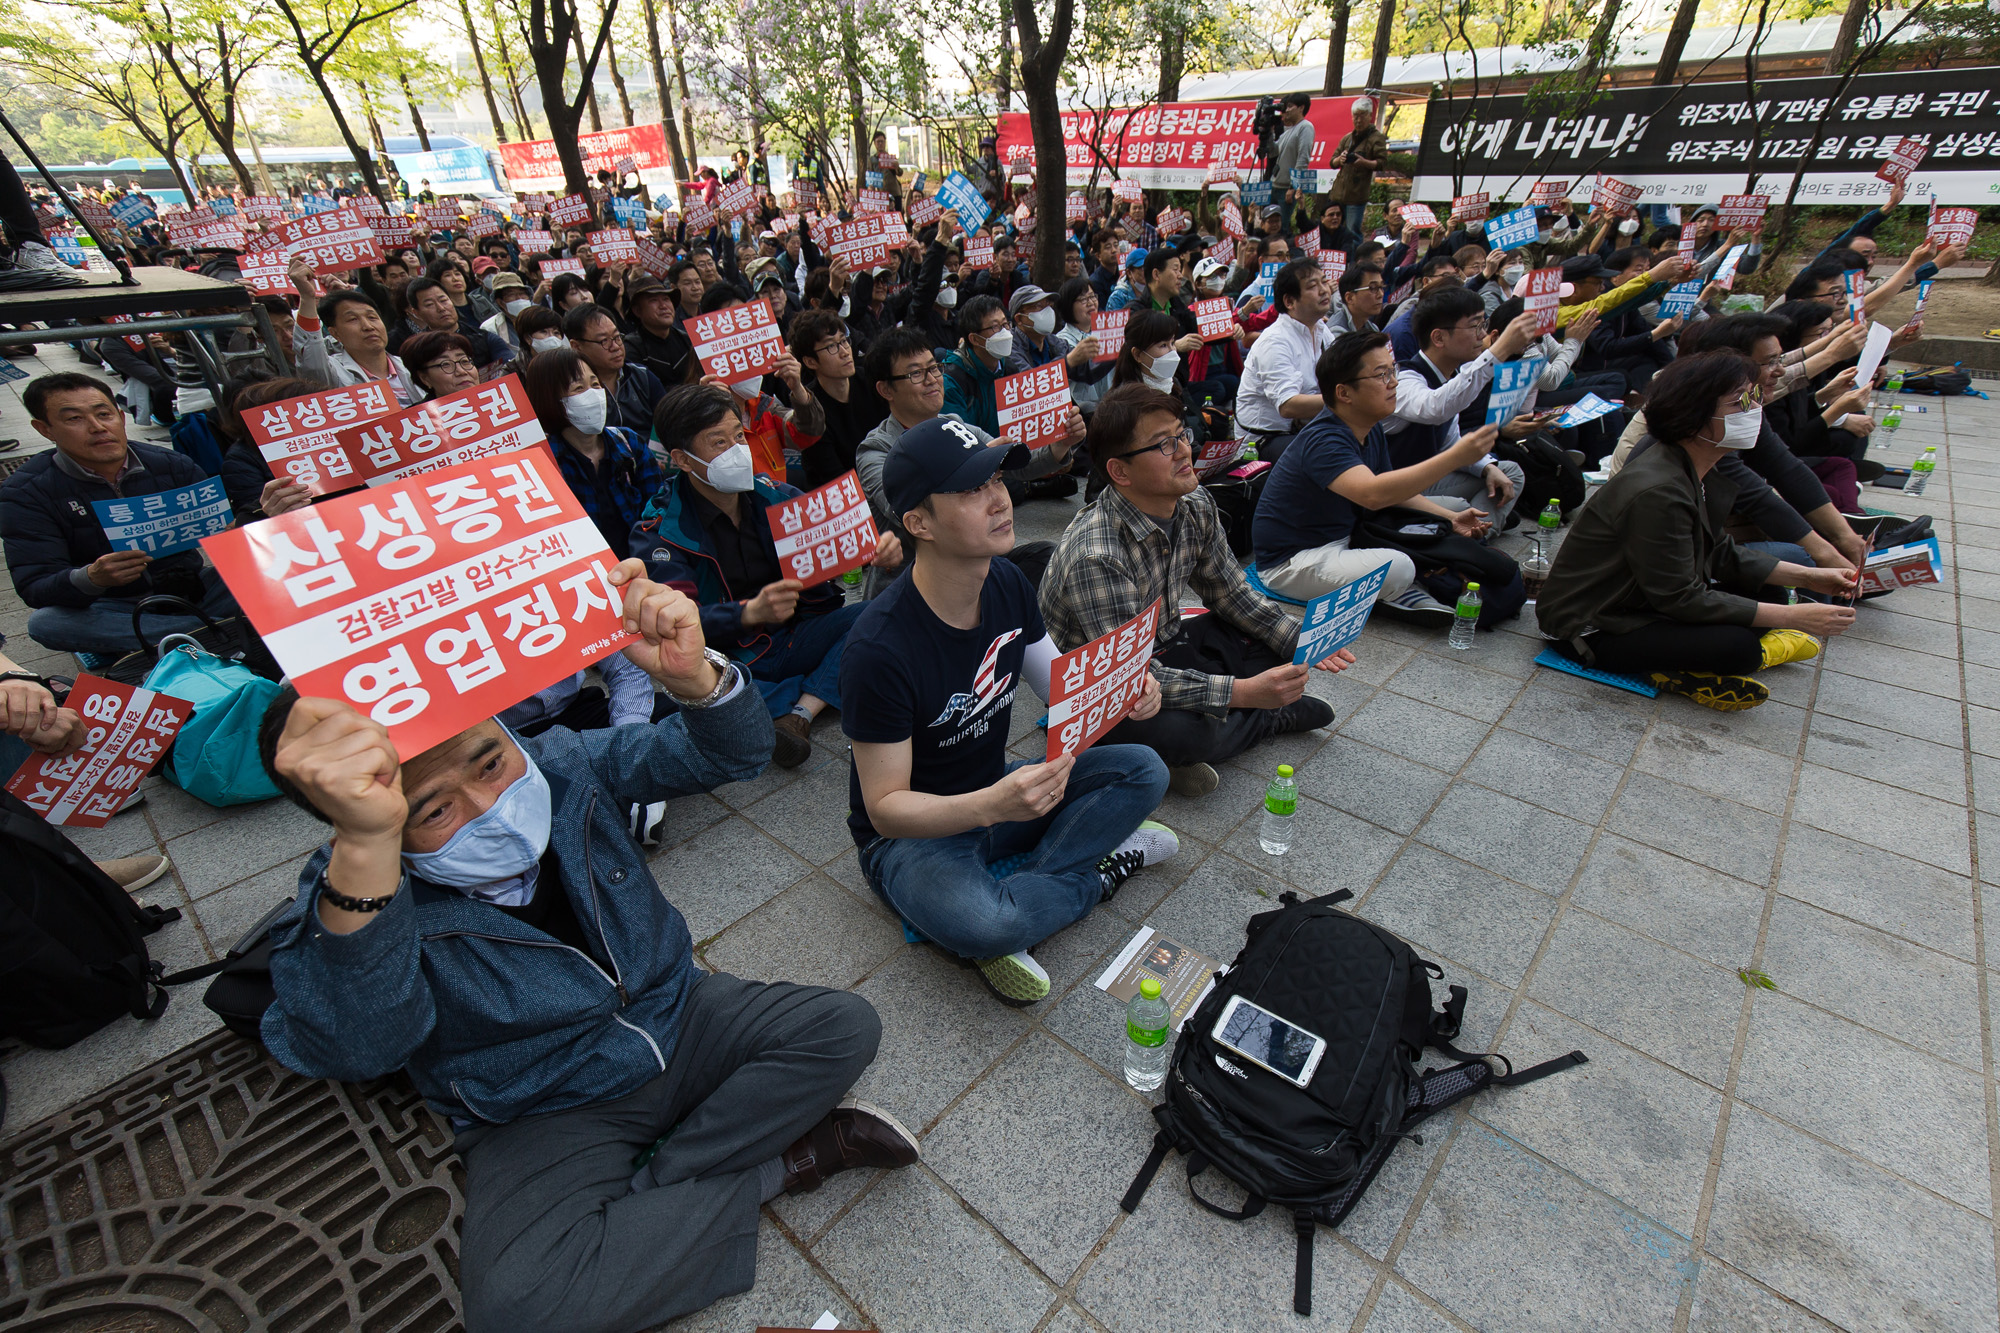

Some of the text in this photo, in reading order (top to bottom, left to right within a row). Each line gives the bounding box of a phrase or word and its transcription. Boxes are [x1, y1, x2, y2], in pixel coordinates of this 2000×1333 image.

[1841, 93, 1923, 121] 유통한
[1928, 90, 1990, 117] 국민
[1127, 141, 1186, 164] 영업정지
[1189, 142, 1206, 163] 후
[1666, 139, 1754, 163] 위조주식
[717, 178, 746, 201] 삼성증권
[861, 190, 888, 199] 삼성증권
[1535, 182, 1566, 193] 삼성증권
[1607, 180, 1641, 198] 삼성증권
[1680, 183, 1707, 196] 21일
[1756, 183, 1780, 197] 장소
[1916, 182, 1932, 195] 앞
[244, 197, 277, 205] 삼성증권
[550, 194, 583, 211] 삼성증권
[962, 183, 975, 196] 큰
[973, 195, 989, 216] 위조
[1454, 193, 1487, 206] 삼성증권
[1725, 196, 1767, 208] 삼성증권
[198, 223, 237, 237] 삼성증권
[285, 208, 361, 240] 삼성증권
[368, 218, 408, 228] 삼성증권
[831, 218, 880, 242] 삼성증권
[1489, 208, 1532, 232] 통 큰 위조
[591, 230, 632, 244] 삼성증권
[967, 237, 991, 249] 삼성증권
[1495, 227, 1535, 248] 112조원
[543, 260, 581, 272] 삼성증권
[598, 248, 636, 263] 영업정지
[1316, 251, 1345, 263] 삼성증권
[1198, 298, 1228, 315] 삼성증권
[695, 301, 770, 341] 삼성증권
[1202, 319, 1232, 336] 영업정지
[710, 337, 739, 352] 검찰고발
[710, 339, 781, 378] 영업정지
[1003, 363, 1064, 405] 삼성증권
[260, 384, 390, 438] 삼성증권
[1011, 403, 1036, 419] 검찰고발
[360, 383, 521, 469] 삼성증권
[942, 421, 978, 449] B
[285, 431, 334, 452] 검찰고발
[109, 504, 134, 523] 통
[142, 495, 167, 518] 큰
[176, 483, 219, 509] 위조
[780, 474, 860, 535] 삼성증권
[122, 524, 155, 535] 삼성이
[159, 517, 179, 529] 하면
[126, 515, 227, 552] 112조원
[264, 458, 563, 608] 삼성증권
[791, 520, 877, 579] 영업정지
[337, 531, 574, 645] 검찰고발 압수수색!
[1311, 570, 1384, 625] 통 큰 위조
[342, 559, 625, 728] 영업정지
[1304, 609, 1368, 662] 112조원
[1062, 605, 1156, 694] 삼성증권
[1071, 652, 1145, 714] 검찰고발 압수수색!
[1060, 666, 1146, 755] 영업정지
[973, 721, 989, 740] USA
[63, 710, 141, 805] 검찰고발 압수수색!
[78, 708, 181, 819] 삼성증권
